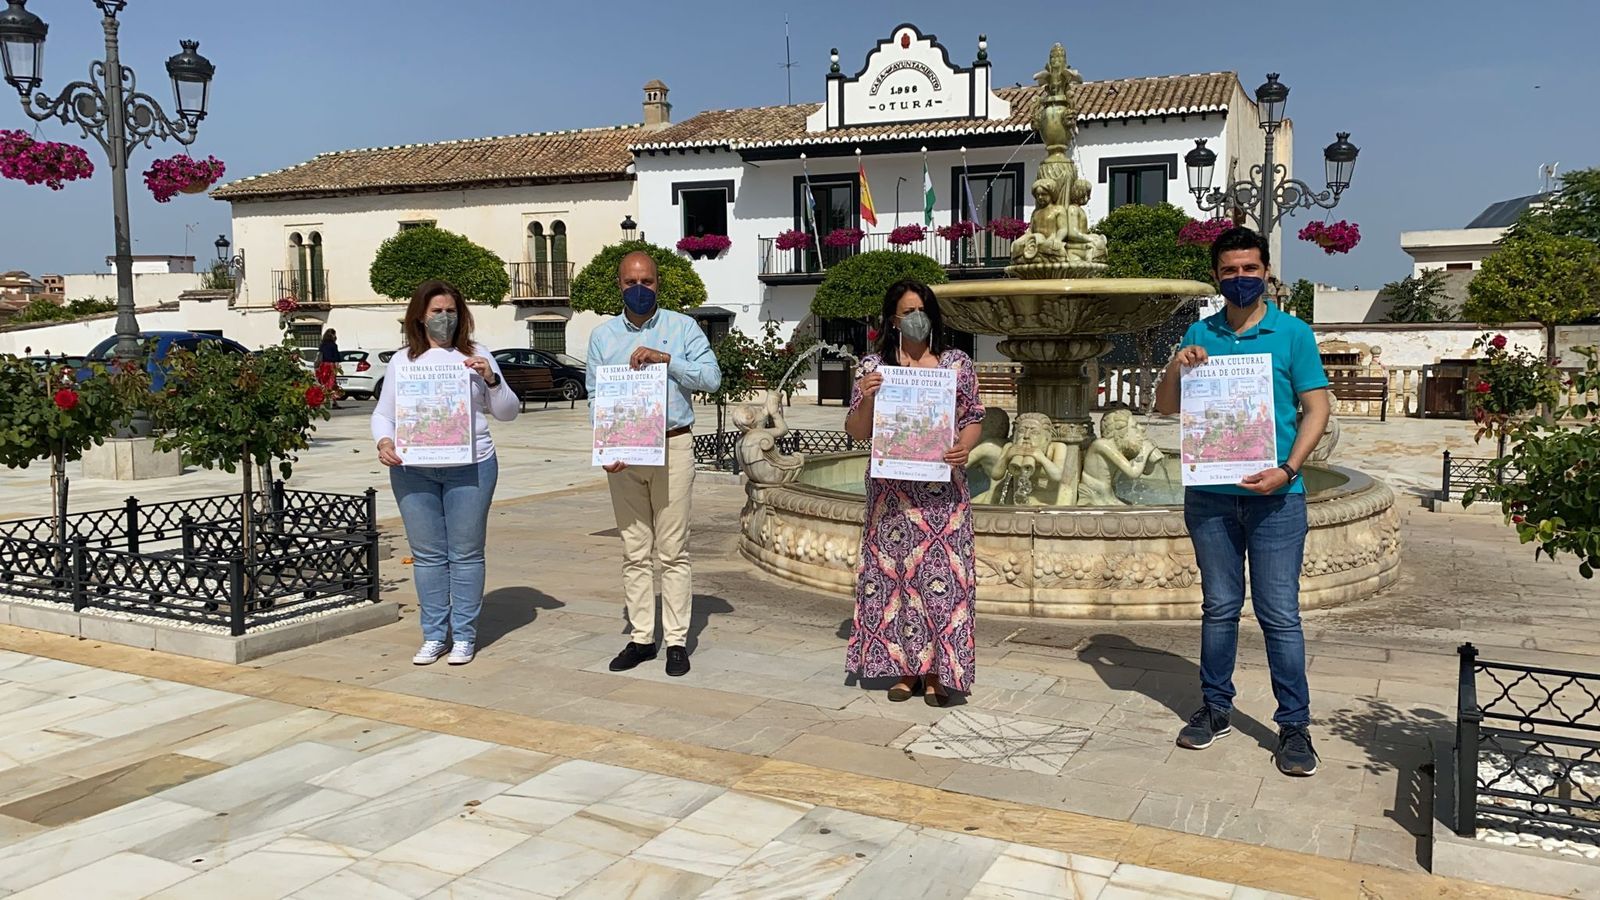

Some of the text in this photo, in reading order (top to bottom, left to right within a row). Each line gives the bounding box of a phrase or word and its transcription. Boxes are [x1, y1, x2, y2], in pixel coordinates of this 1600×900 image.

[871, 61, 940, 93] CASA AYUNTAMIENTO
[1227, 356, 1265, 366] CULTURAL
[409, 373, 426, 381] VILLA
[892, 368, 917, 377] SEMANA
[919, 369, 951, 379] CULTURAL
[1196, 367, 1256, 378] VILLA DE OTURA
[609, 374, 625, 382] VILLA
[891, 377, 942, 387] VILLA DE OTURA
